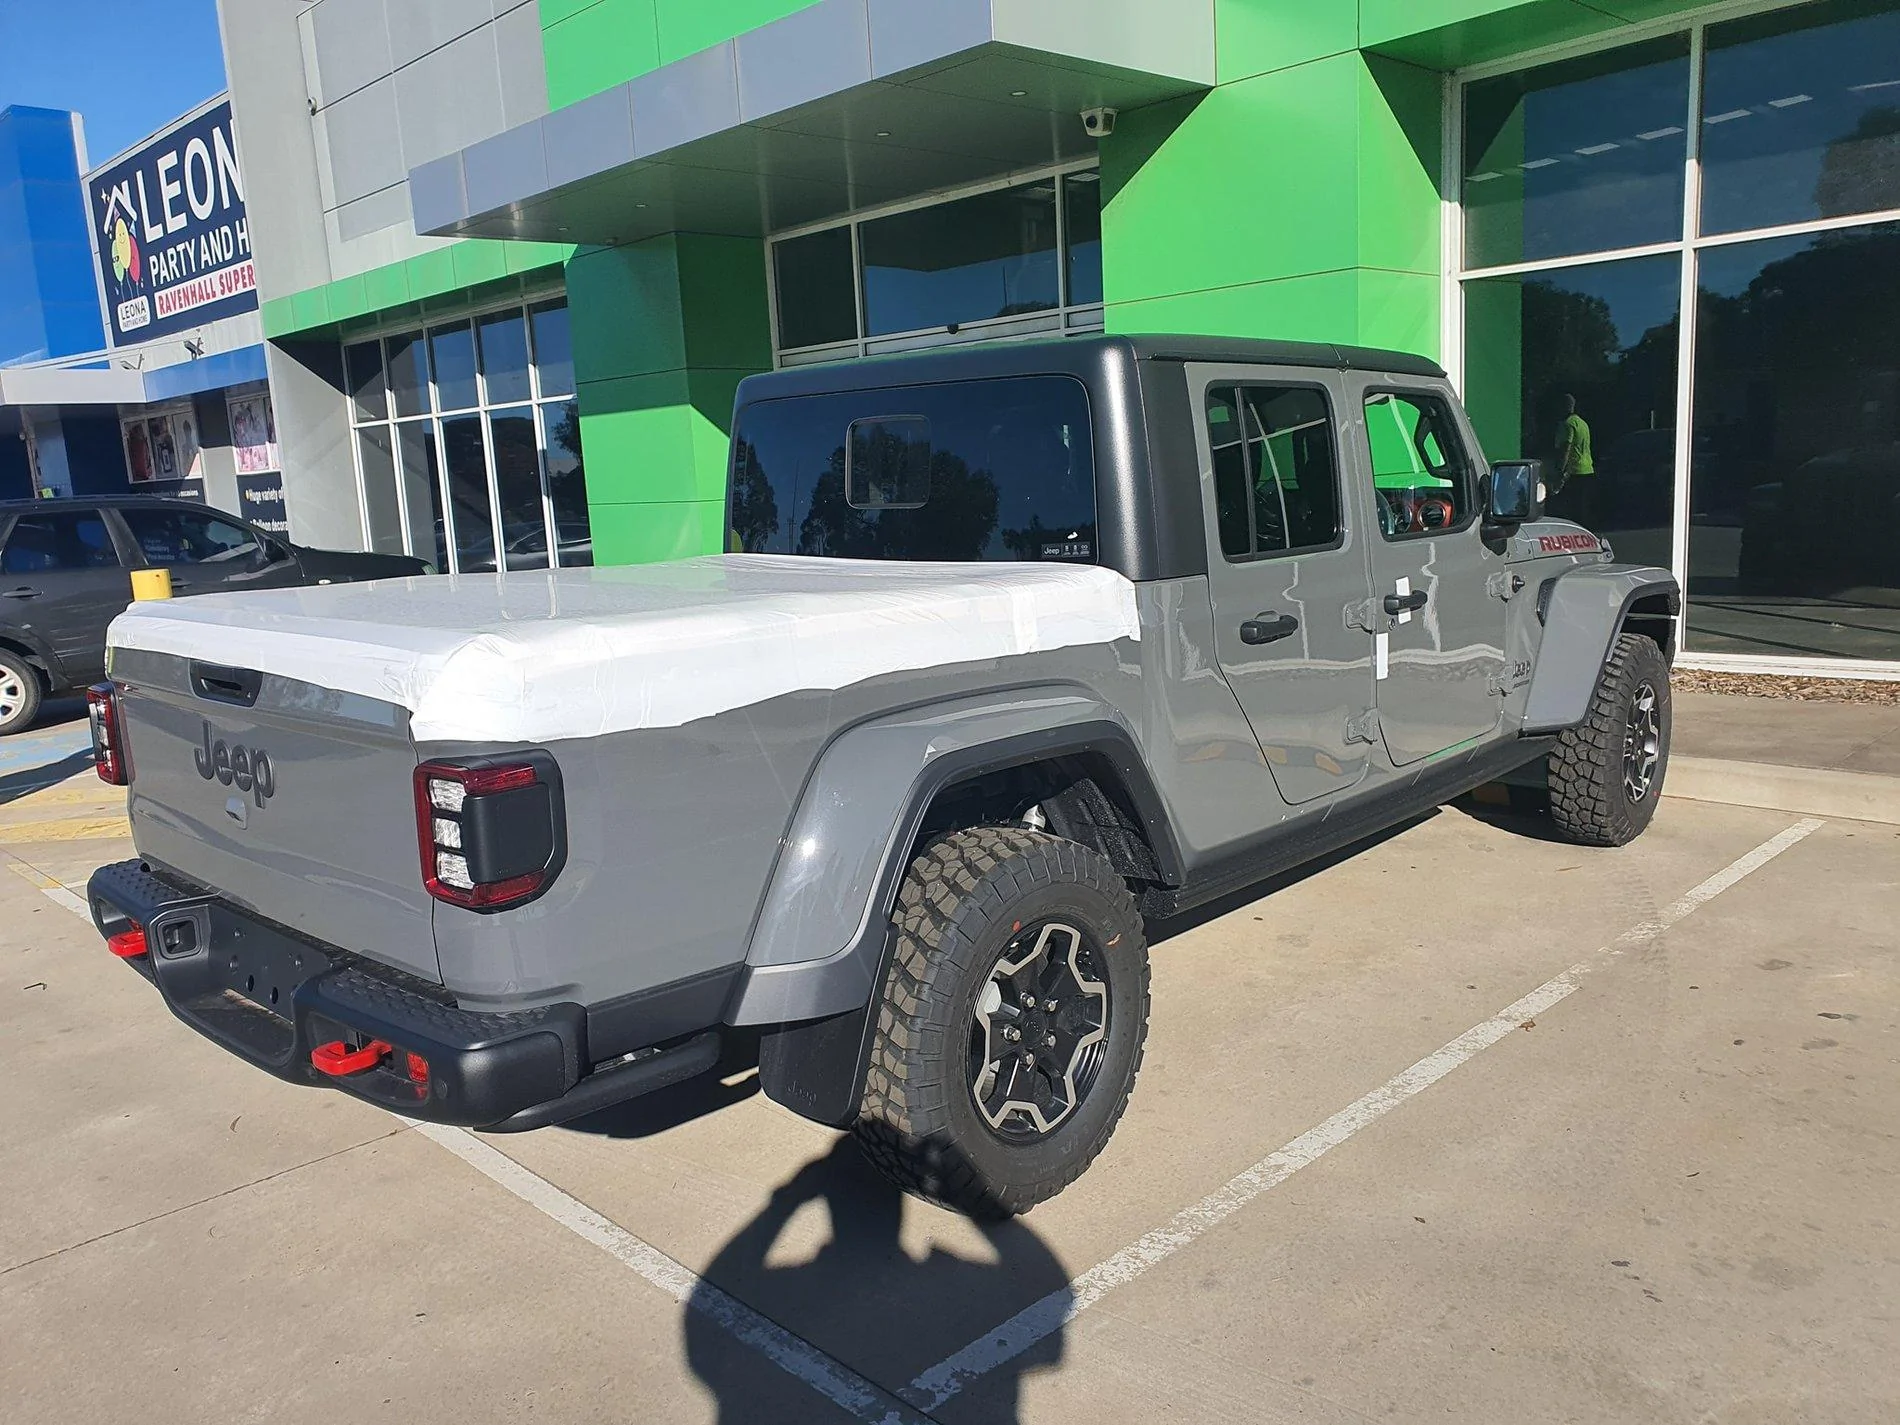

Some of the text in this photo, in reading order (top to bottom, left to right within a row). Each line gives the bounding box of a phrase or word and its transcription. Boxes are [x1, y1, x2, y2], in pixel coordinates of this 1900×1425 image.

[149, 240, 197, 287] PARTY
[200, 224, 234, 269] AND
[158, 264, 256, 315] RAVENHALL SUPER
[120, 300, 147, 320] LEONA
[1044, 547, 1060, 555] Jeep
[1537, 533, 1598, 552] RUBICON
[194, 719, 275, 809] Jeep
